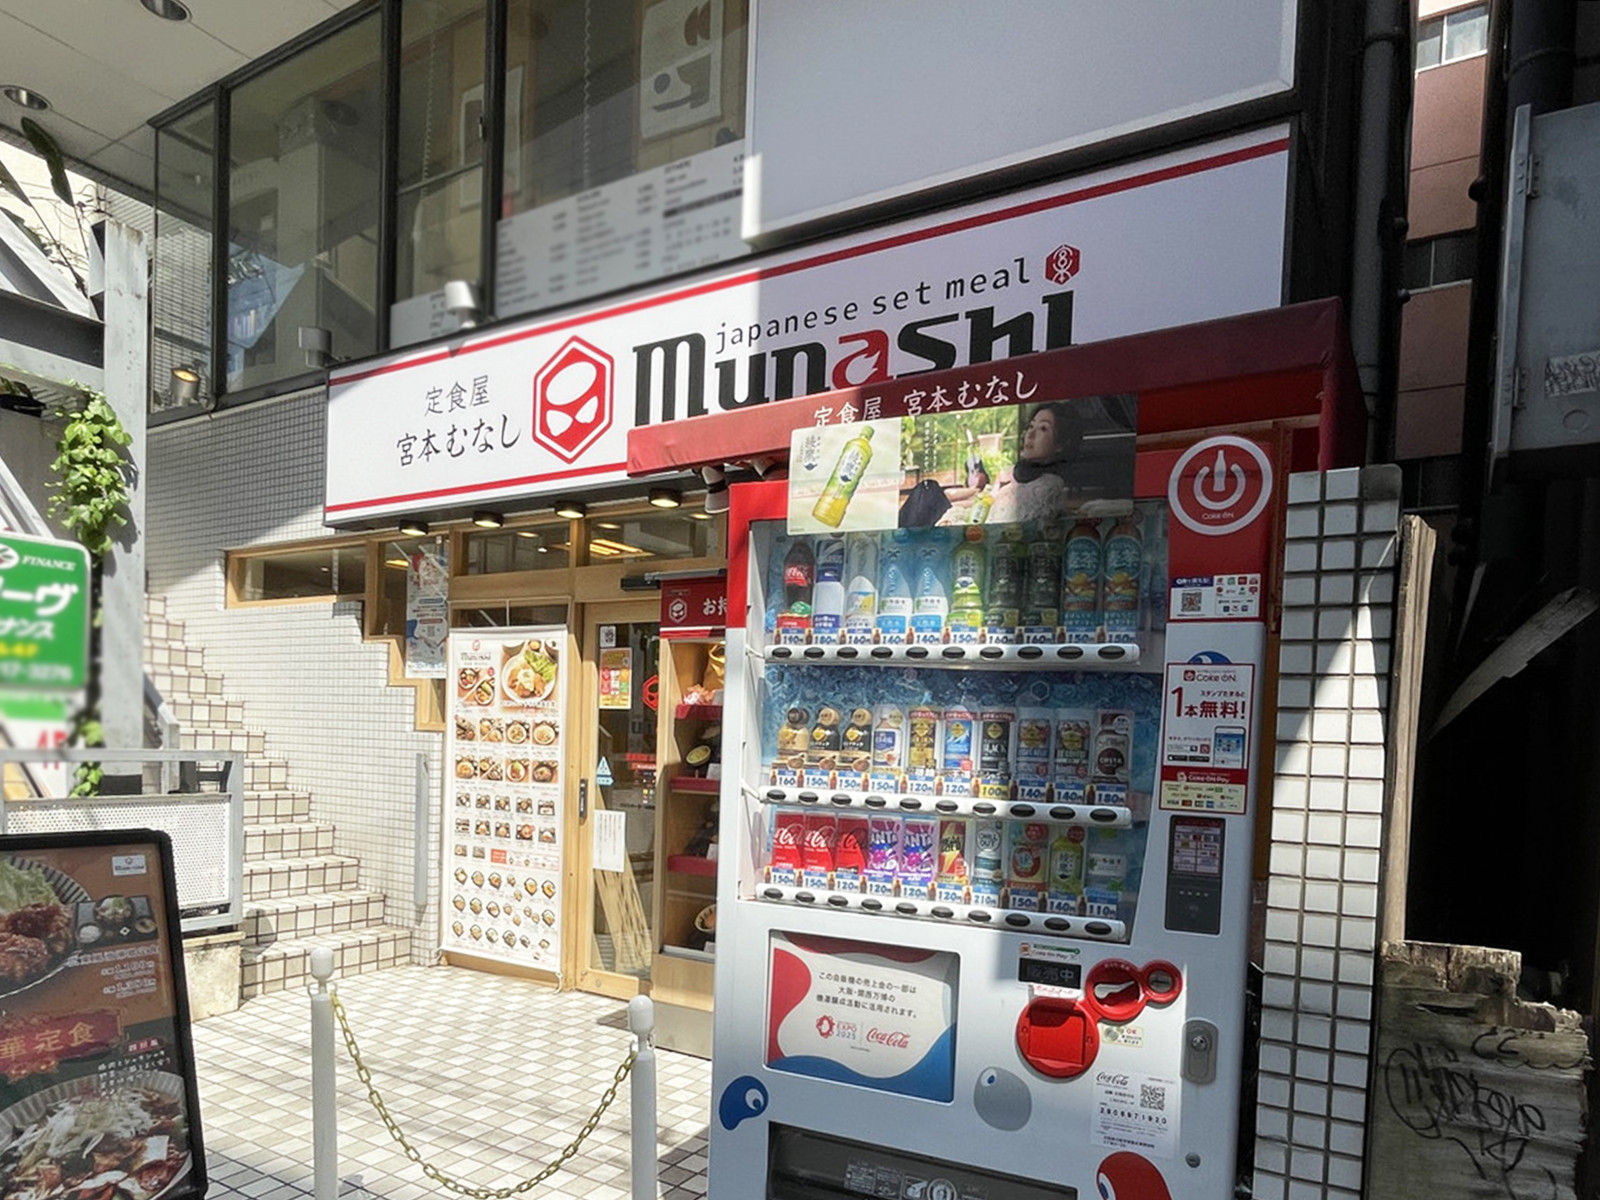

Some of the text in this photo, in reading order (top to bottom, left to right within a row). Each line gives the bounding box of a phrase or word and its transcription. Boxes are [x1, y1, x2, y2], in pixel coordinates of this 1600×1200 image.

[715, 257, 1030, 354] japanese set meal
[424, 374, 491, 417] 定食屋
[813, 371, 1038, 427] 定食屋 宮本むなし
[396, 413, 522, 467] 宮本むなし
[22, 555, 76, 571] FINANCE
[0, 576, 79, 616] ーヴ
[0, 1021, 95, 1061] 華定食
[836, 1021, 857, 1032] EXPO
[836, 1030, 857, 1040] 2025
